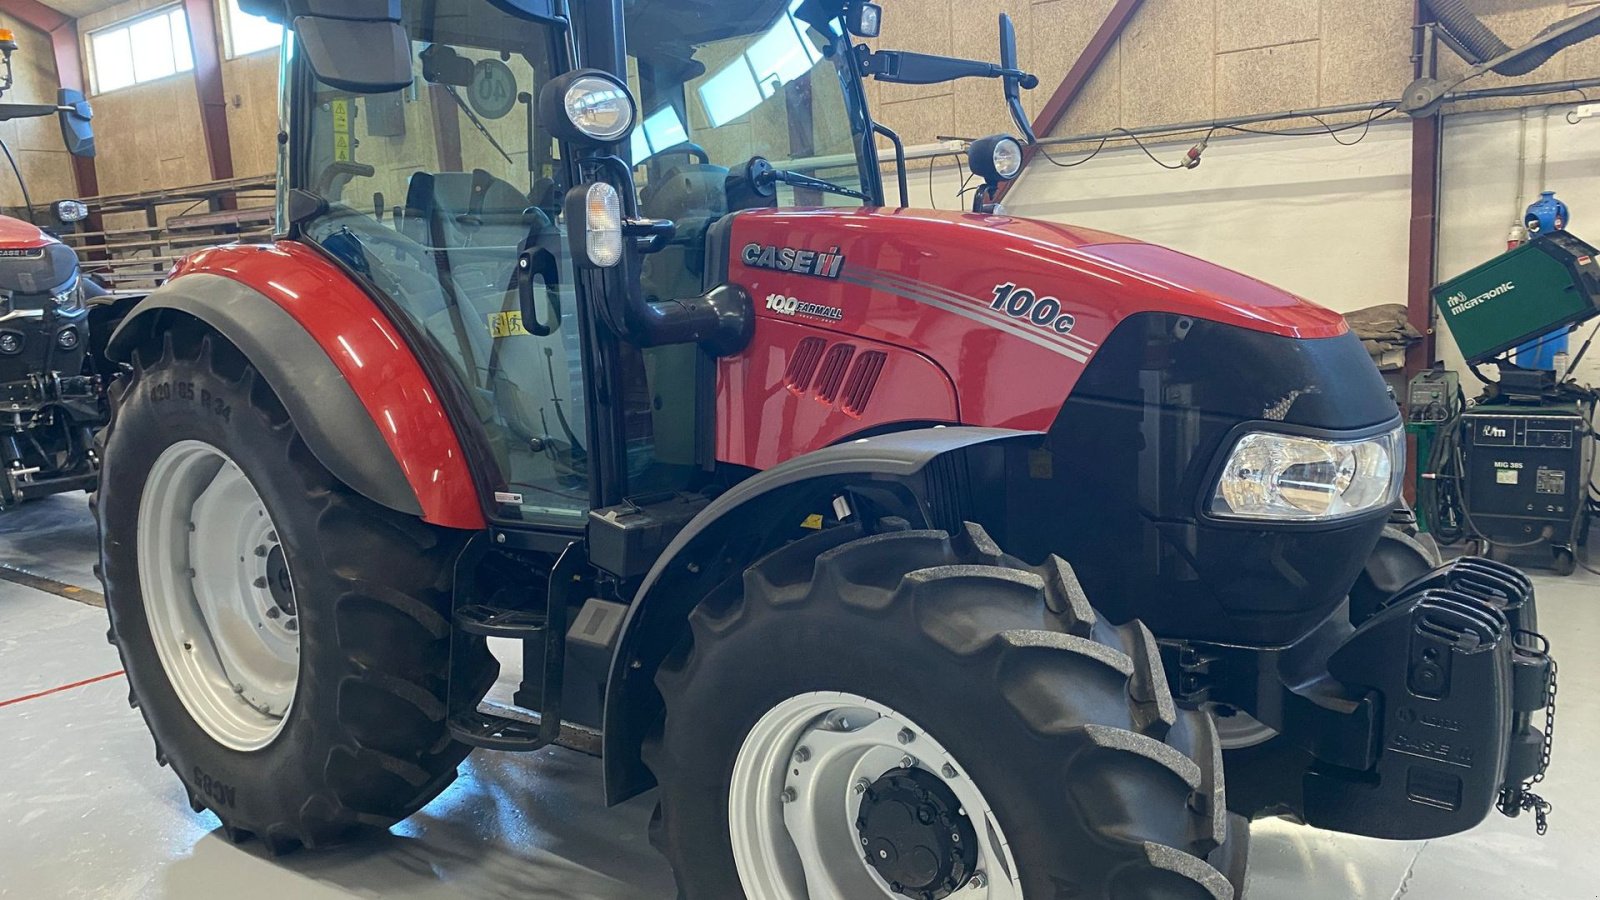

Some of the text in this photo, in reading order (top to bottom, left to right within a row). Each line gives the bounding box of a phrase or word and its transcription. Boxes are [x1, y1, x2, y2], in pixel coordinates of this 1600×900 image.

[741, 242, 815, 274] CASE
[765, 293, 798, 314] 100
[796, 301, 843, 321] FARMALL
